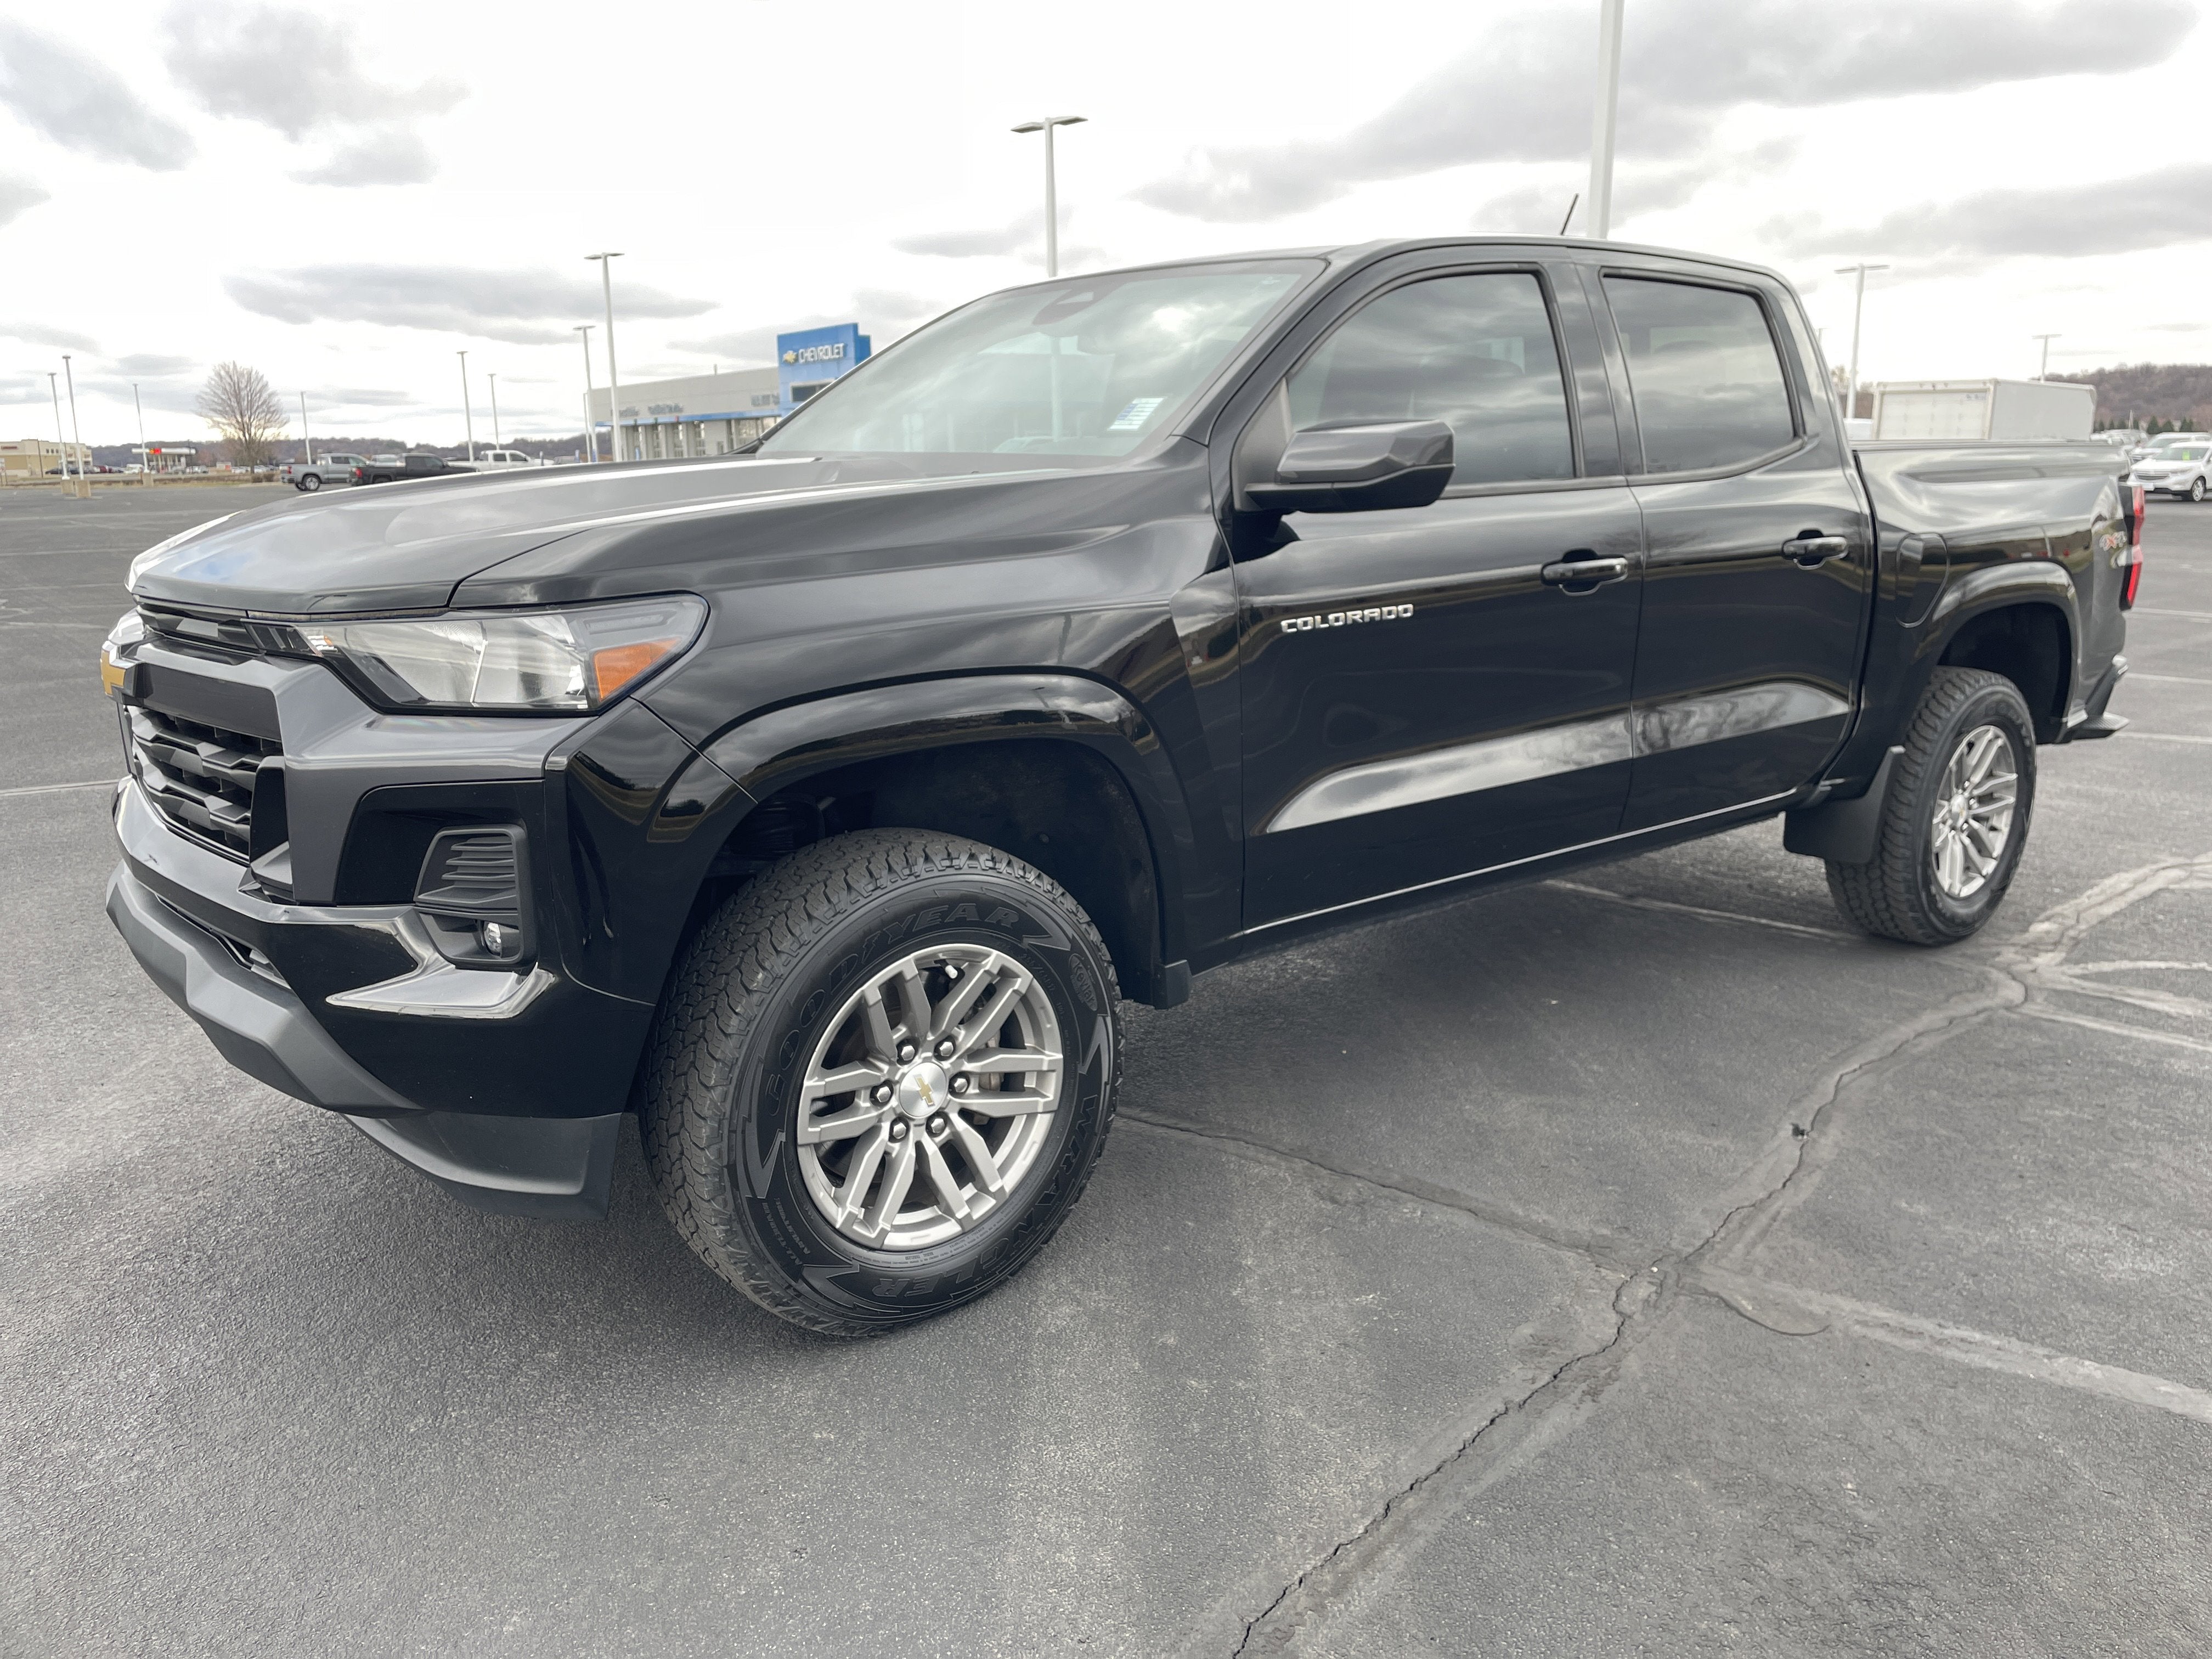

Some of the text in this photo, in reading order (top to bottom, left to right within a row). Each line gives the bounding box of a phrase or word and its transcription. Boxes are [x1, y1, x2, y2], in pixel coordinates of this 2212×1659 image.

[798, 343, 844, 363] CHEVROLET
[1280, 603, 1414, 633] COLORADO
[1073, 961, 1096, 1003] Kevlar
[766, 903, 1019, 1116] GOODYEAR
[872, 1094, 1098, 1297] WRANGLER
